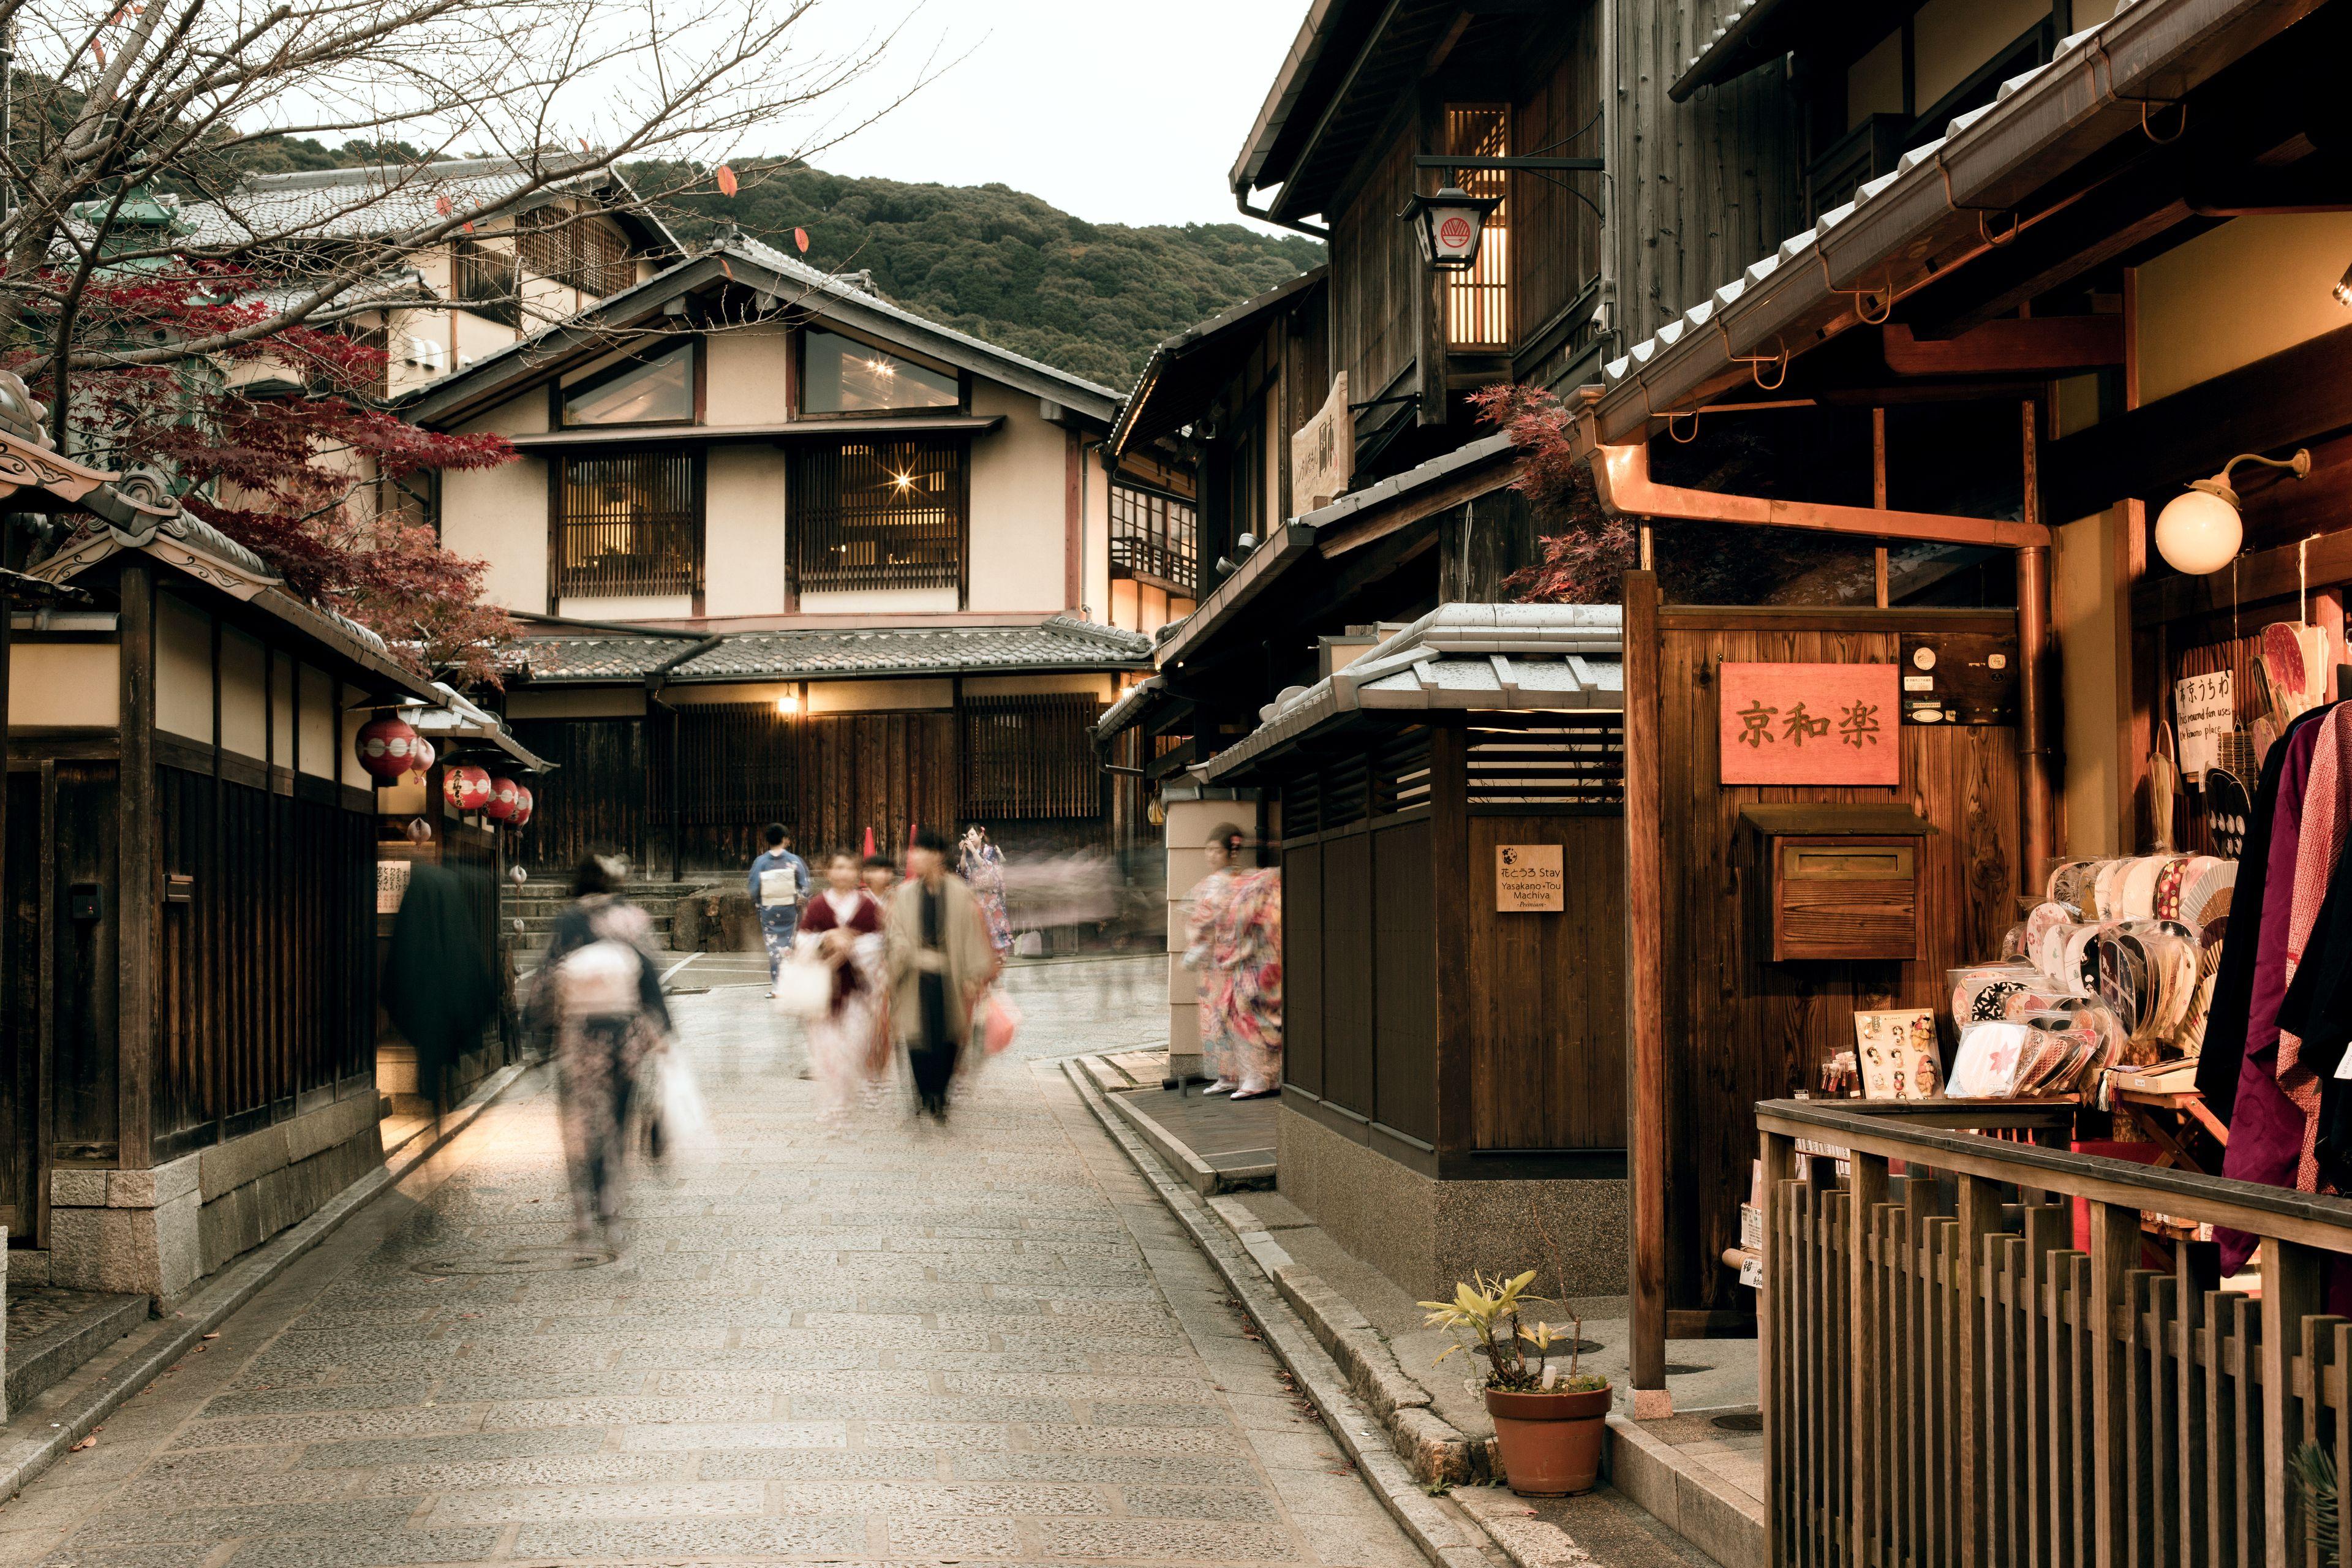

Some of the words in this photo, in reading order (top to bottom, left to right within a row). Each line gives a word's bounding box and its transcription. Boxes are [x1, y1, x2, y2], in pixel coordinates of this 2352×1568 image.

[1736, 699, 1881, 750] 京和楽
[2177, 712, 2187, 726] This
[2188, 708, 2205, 723] round
[2205, 707, 2216, 719] fan
[2218, 708, 2231, 717] uses
[2186, 728, 2202, 739] kimono
[2205, 723, 2222, 741] place
[1501, 868, 1536, 878] 花とうろ
[1539, 868, 1561, 878] Stay
[1513, 891, 1550, 900] Machiya
